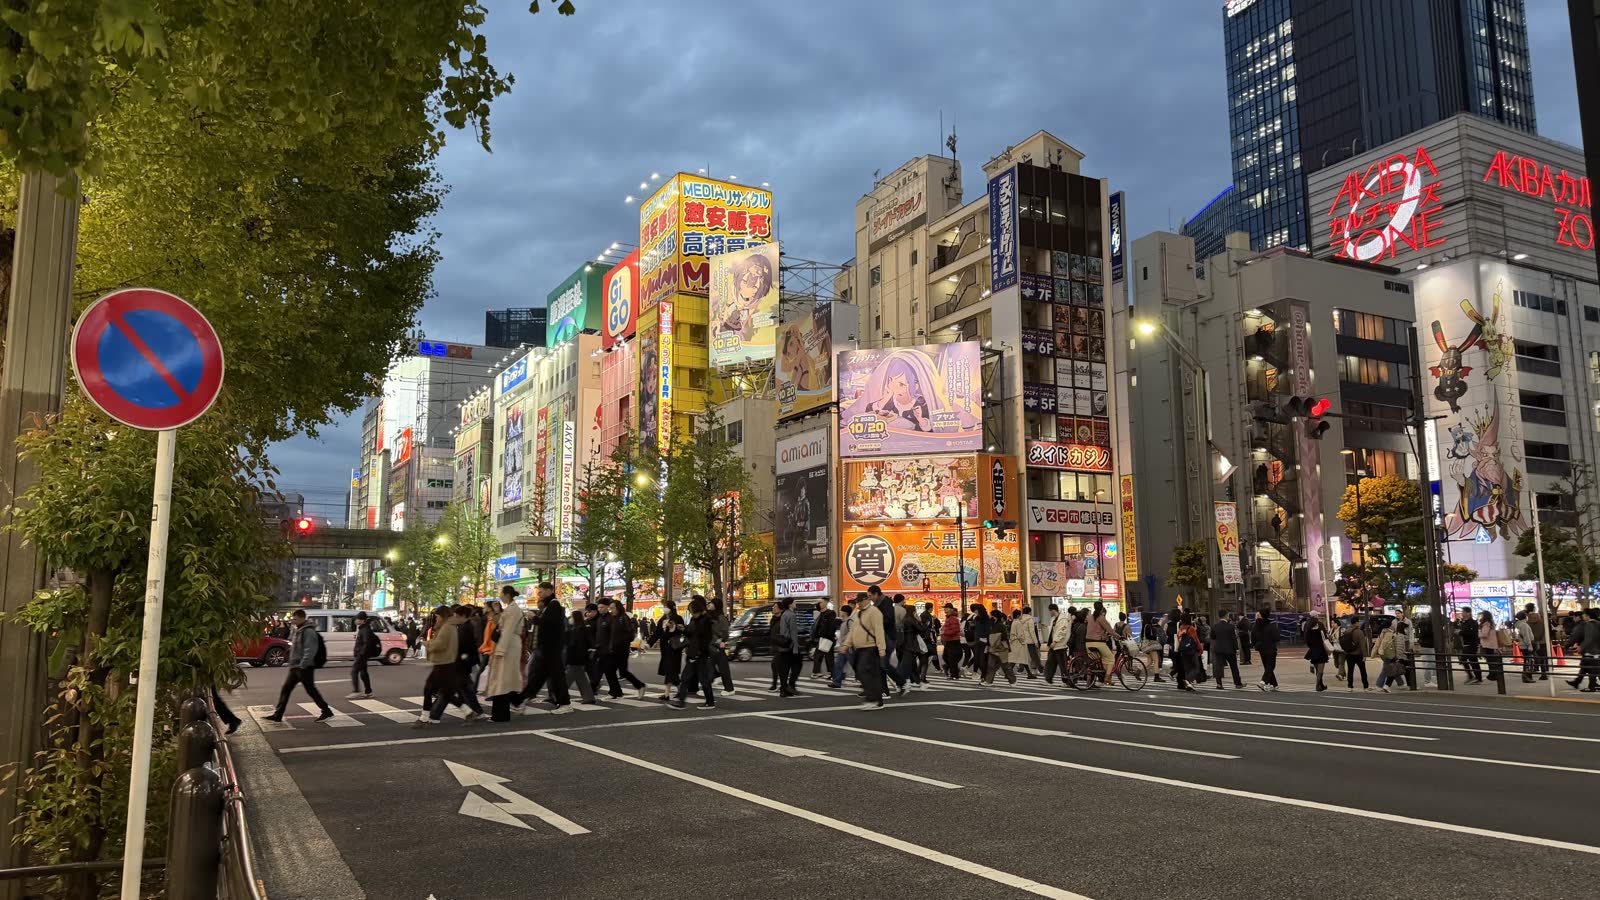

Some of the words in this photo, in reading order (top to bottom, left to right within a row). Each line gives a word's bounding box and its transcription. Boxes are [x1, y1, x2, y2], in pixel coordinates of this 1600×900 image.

[1328, 146, 1439, 215] AKIBA
[682, 181, 769, 208] MEDIAリサイクル
[684, 201, 769, 236] 激安販売
[1329, 181, 1443, 239] カルチャーズ
[1329, 206, 1446, 264] ZONE
[1037, 288, 1052, 302] 7F
[713, 336, 739, 348] 10/20
[1038, 342, 1054, 355] 6F
[1297, 364, 1307, 394] cafe
[1041, 398, 1056, 410] 5F
[564, 423, 574, 453] AKKY
[849, 421, 885, 434] 10/20
[781, 440, 822, 464] amiami
[1029, 445, 1109, 468] メイドカジノ
[563, 461, 573, 503] Tax-free
[562, 503, 572, 529] Shop
[1046, 509, 1113, 525] スマホ修理王
[923, 532, 977, 551] 大黒屋
[853, 543, 889, 580] 質
[790, 582, 808, 592] COMIC
[808, 582, 817, 592] ZIN
[1047, 571, 1058, 582] 22
